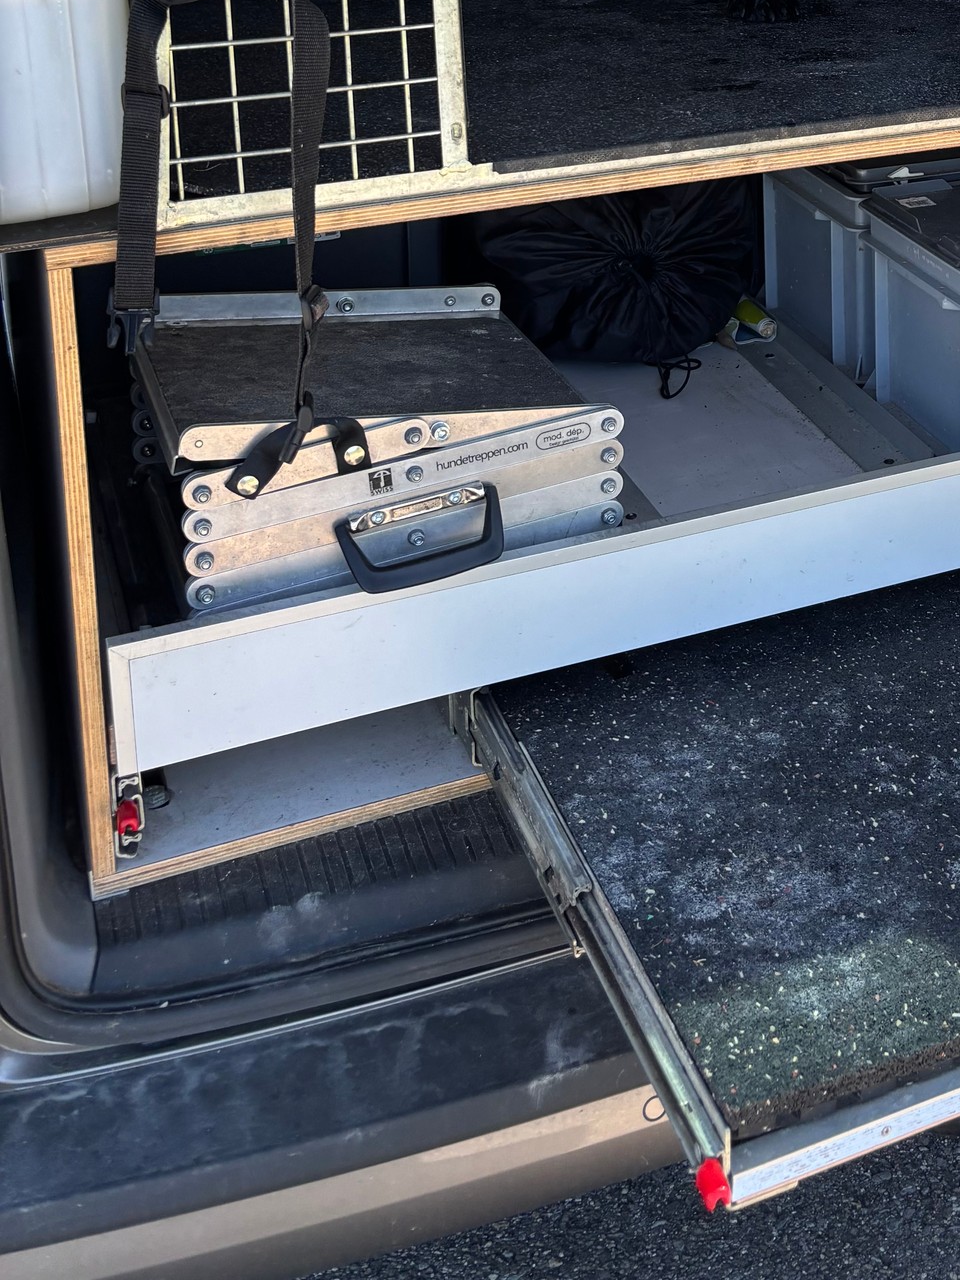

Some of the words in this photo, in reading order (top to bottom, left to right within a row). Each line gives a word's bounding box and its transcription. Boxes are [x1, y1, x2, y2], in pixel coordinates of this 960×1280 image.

[543, 431, 564, 443] mod.
[566, 428, 585, 437] dép.
[436, 442, 528, 471] hundetreppen.com
[370, 486, 393, 497] SWISS
